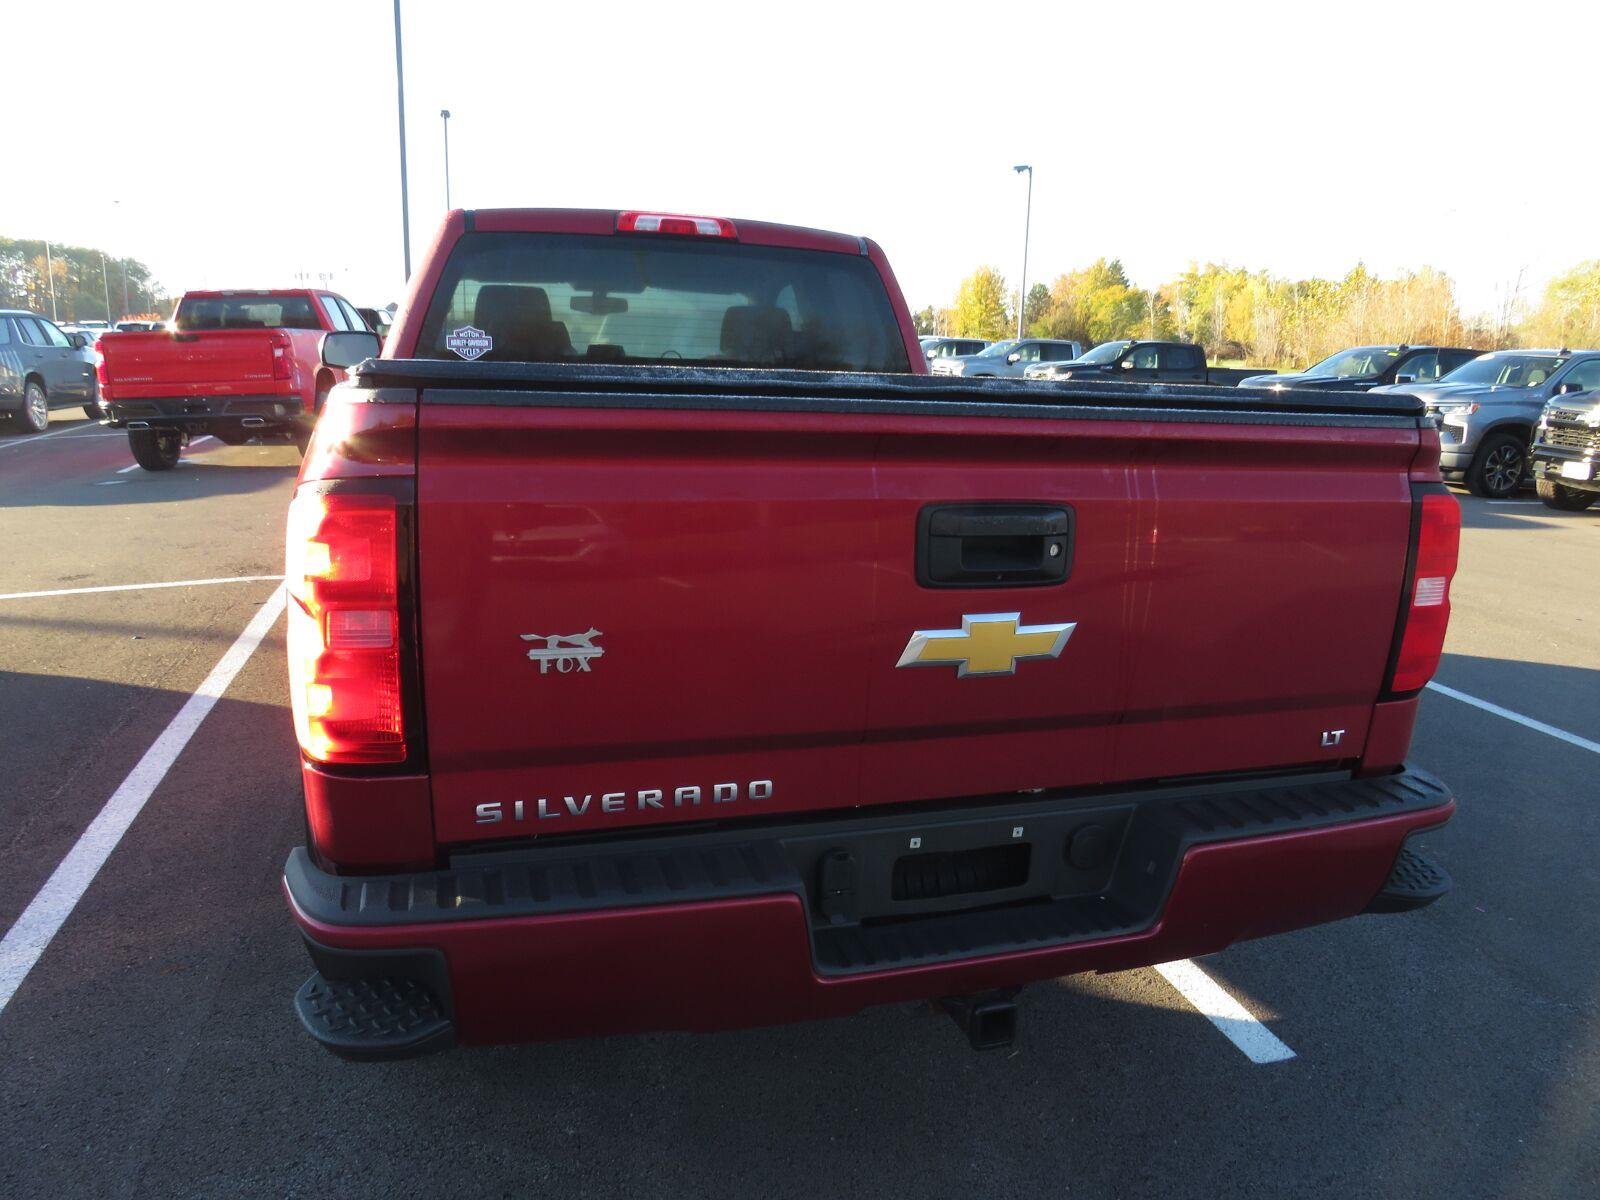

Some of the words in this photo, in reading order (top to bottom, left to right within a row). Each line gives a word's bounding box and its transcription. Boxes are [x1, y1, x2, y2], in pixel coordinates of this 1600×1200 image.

[459, 330, 480, 338] MOTOR
[459, 347, 480, 357] CYCLES
[540, 655, 592, 674] FOX
[1321, 729, 1345, 747] LT
[475, 779, 773, 824] SILVERADO
